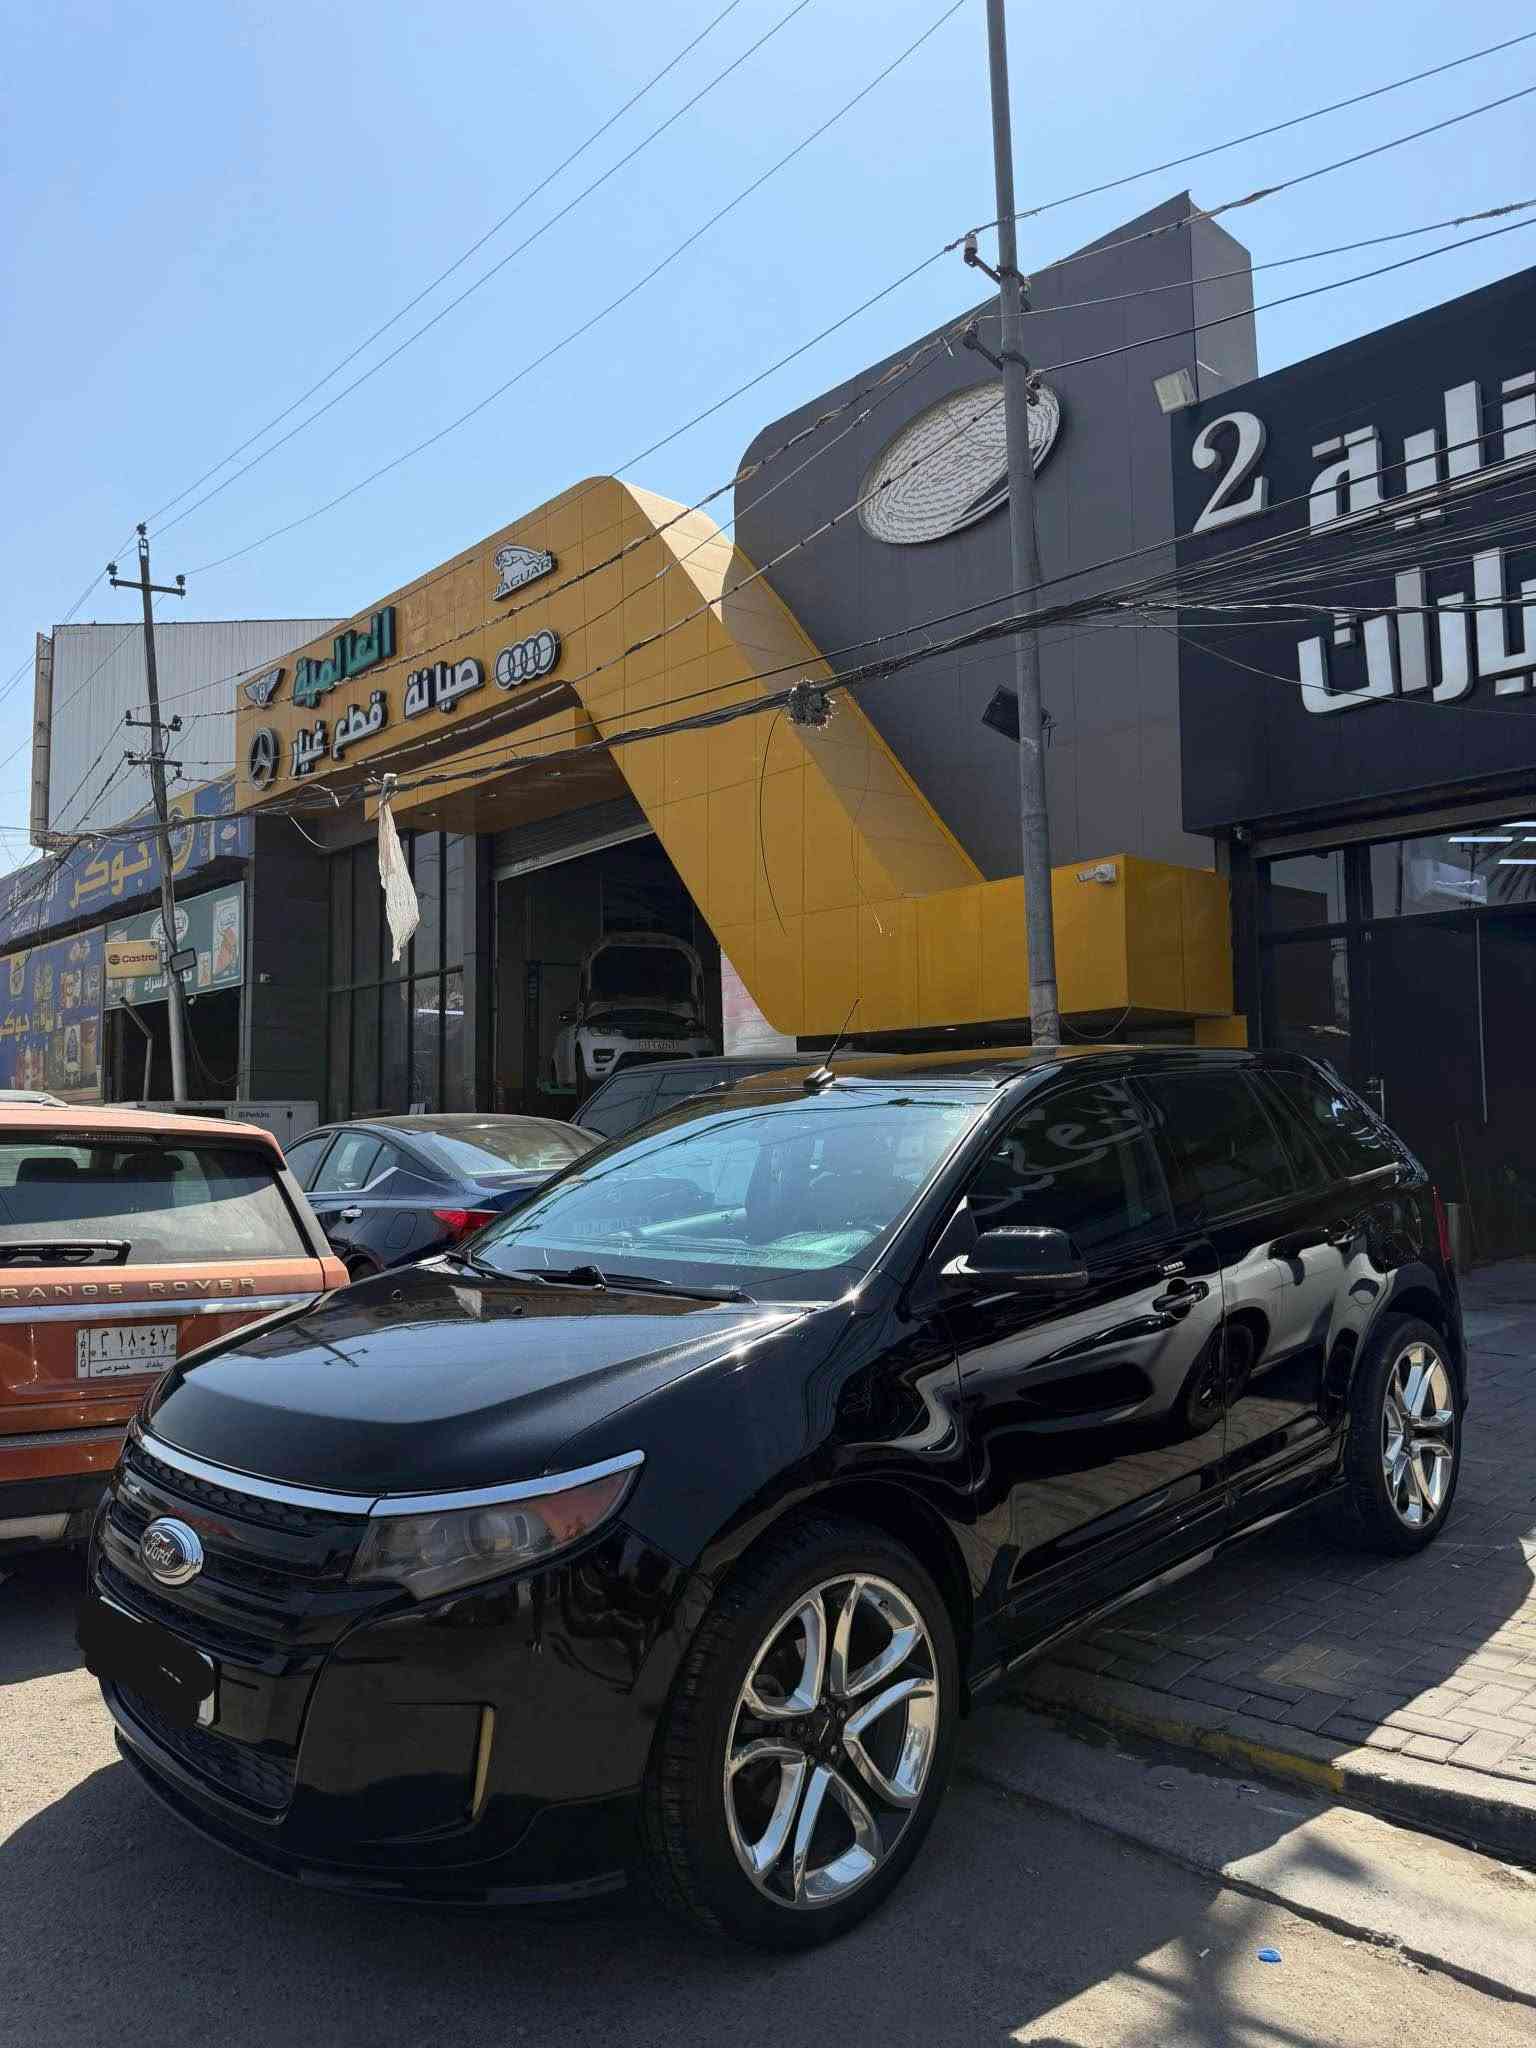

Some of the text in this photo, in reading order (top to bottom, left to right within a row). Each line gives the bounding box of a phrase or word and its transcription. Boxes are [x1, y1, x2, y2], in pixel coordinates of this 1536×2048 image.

[1192, 411, 1265, 533] 2
[495, 557, 551, 597] JAGUAR
[290, 656, 485, 777] صيانة قطع غيار
[121, 953, 158, 964] Castrol
[0, 1277, 256, 1300] RANGE ROVER
[145, 1532, 177, 1566] Ford
